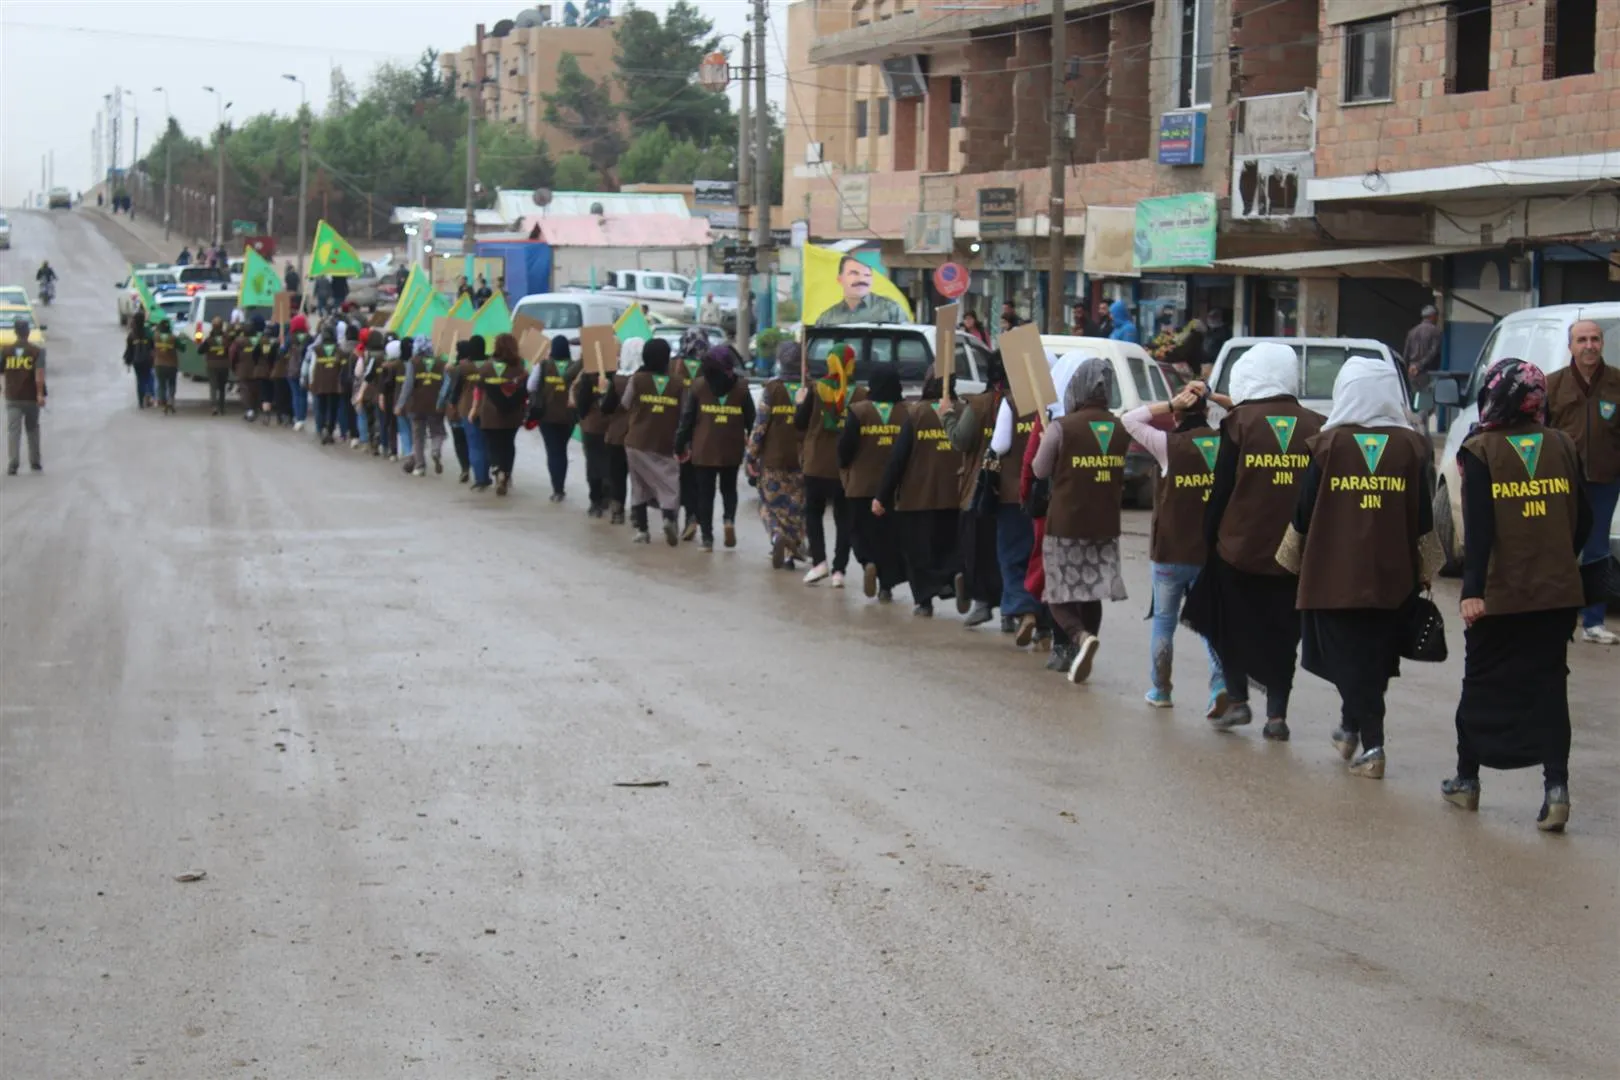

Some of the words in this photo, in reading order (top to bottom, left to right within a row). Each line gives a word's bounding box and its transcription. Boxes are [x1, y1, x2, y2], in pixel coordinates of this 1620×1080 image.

[1272, 472, 1294, 485] JIN
[1360, 495, 1382, 509] JIN
[1522, 500, 1547, 517] JIN
